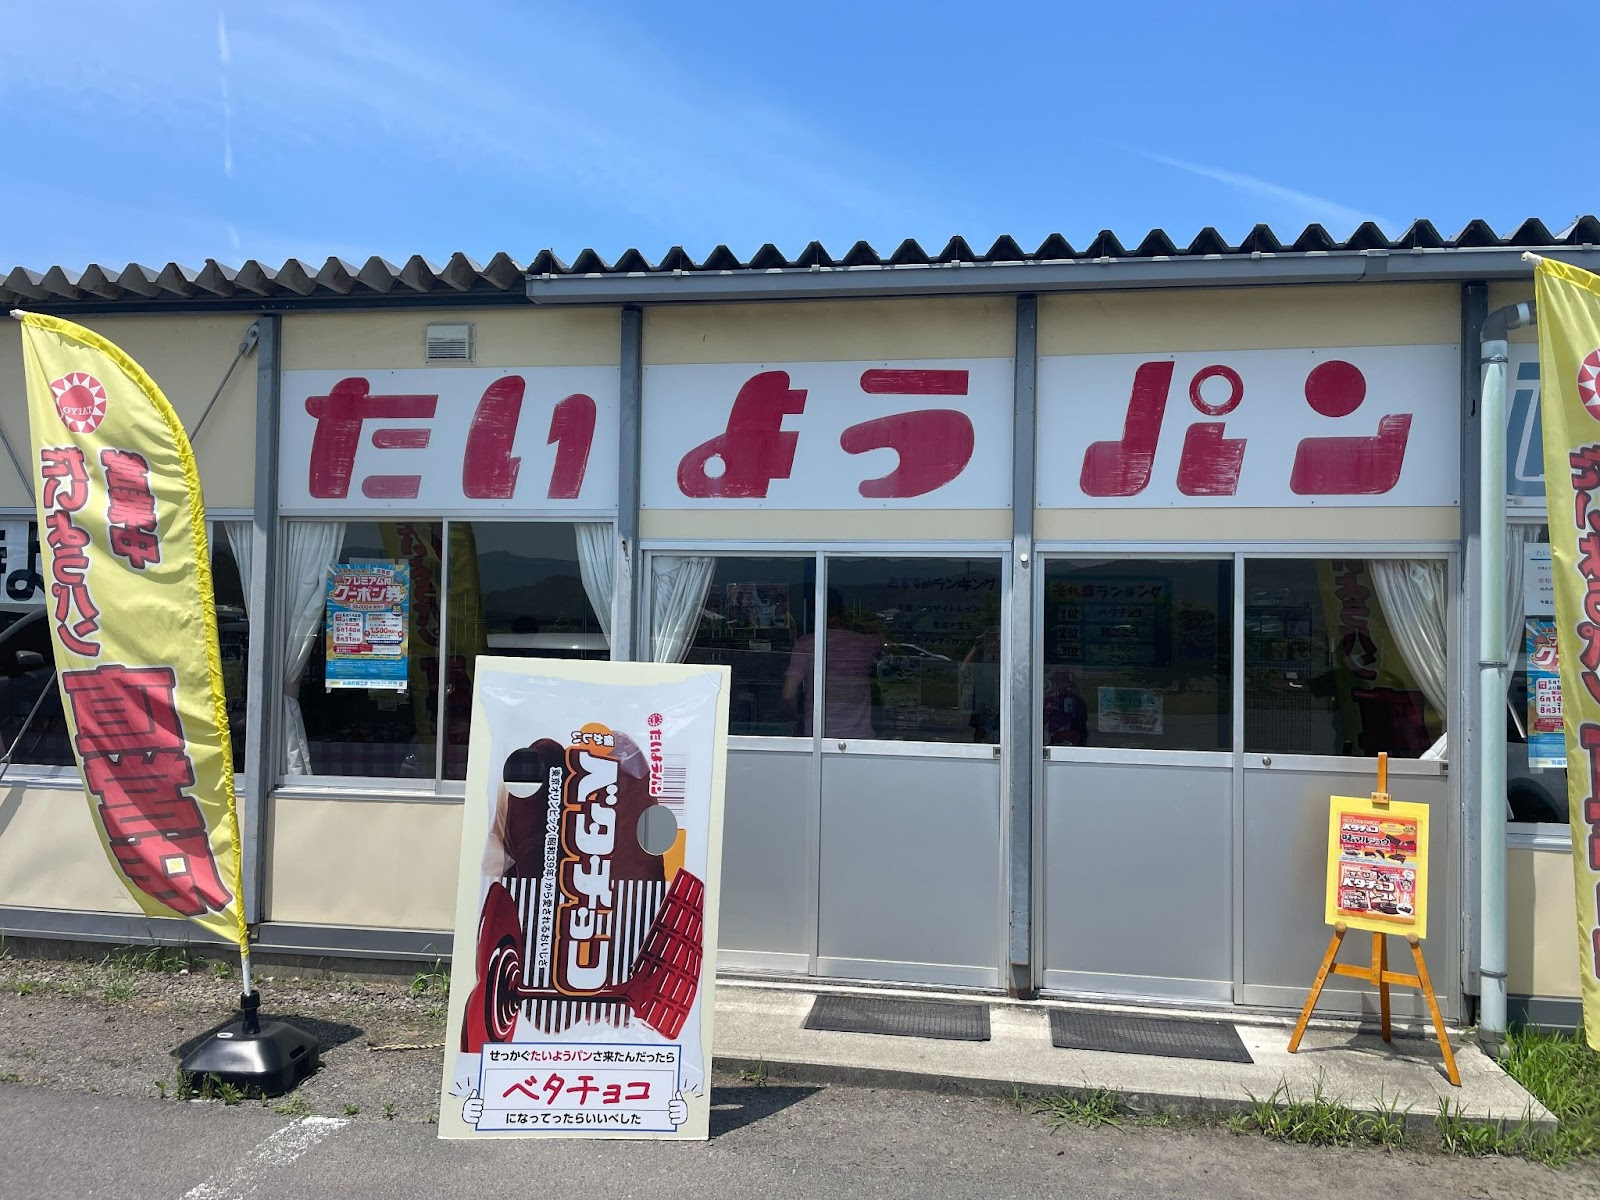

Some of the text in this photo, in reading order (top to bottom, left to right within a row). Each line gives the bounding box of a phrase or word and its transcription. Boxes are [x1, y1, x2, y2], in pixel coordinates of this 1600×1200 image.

[334, 585, 403, 602] クーポン券
[648, 729, 663, 796] たいようパン
[566, 750, 619, 990] ベタチョコ
[1342, 877, 1395, 892] ベタチョコ
[502, 1073, 651, 1105] ベタチョコ
[506, 1112, 641, 1125] になってったらいいべした
